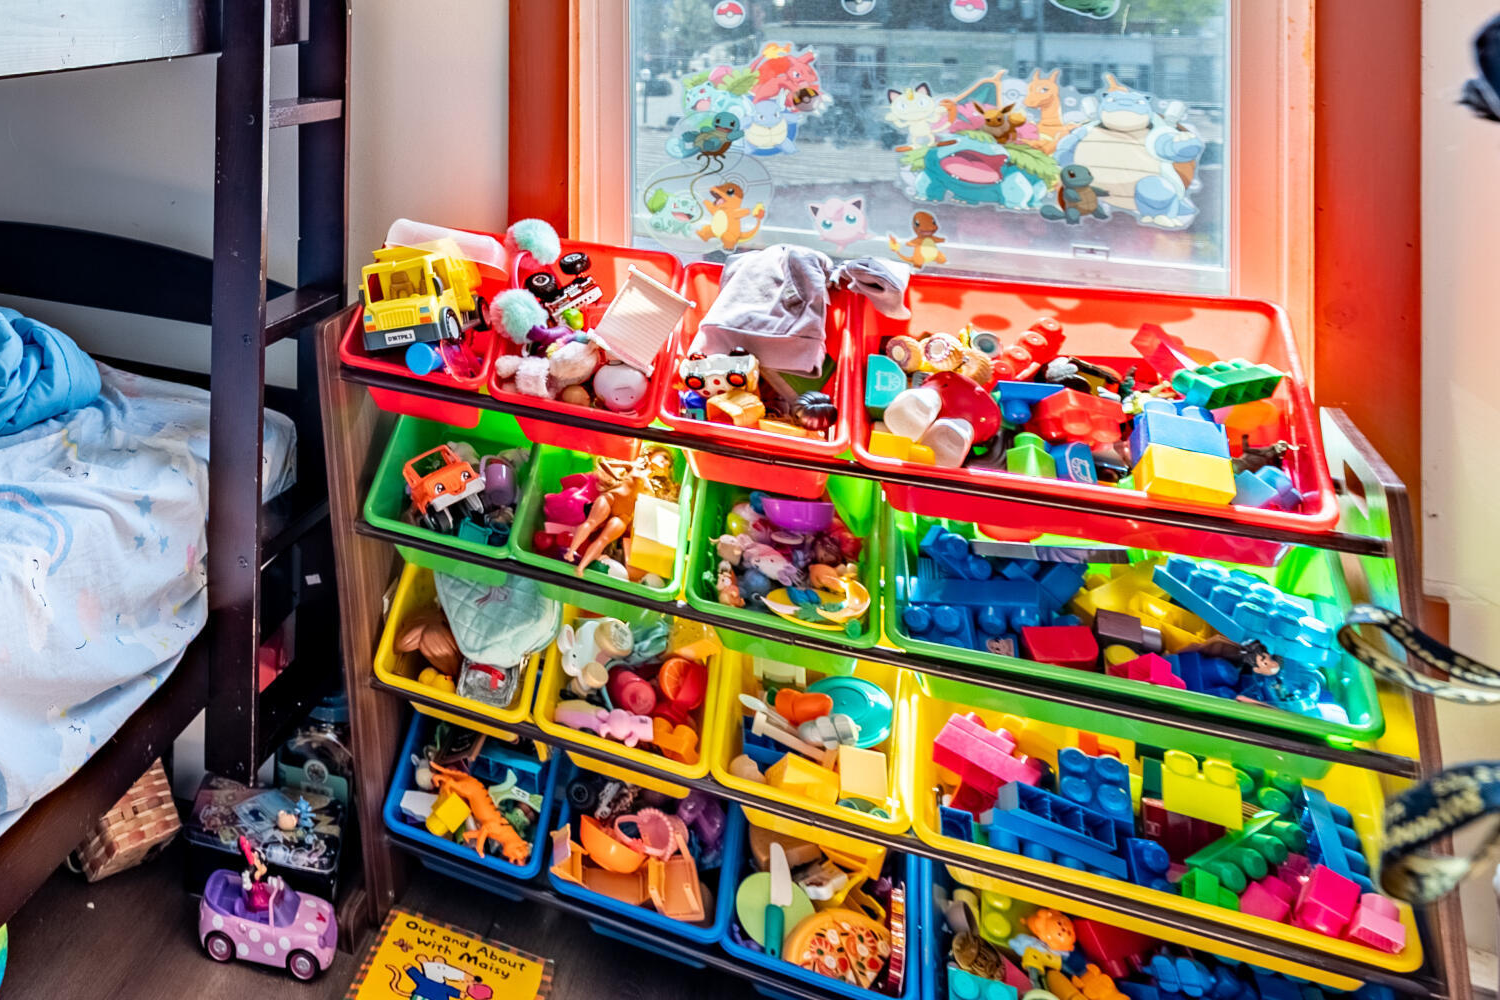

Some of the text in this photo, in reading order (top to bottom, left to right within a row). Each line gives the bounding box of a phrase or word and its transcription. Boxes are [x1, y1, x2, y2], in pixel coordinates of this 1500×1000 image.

[405, 920, 527, 972] Out and About
[458, 951, 511, 980] Maisy
